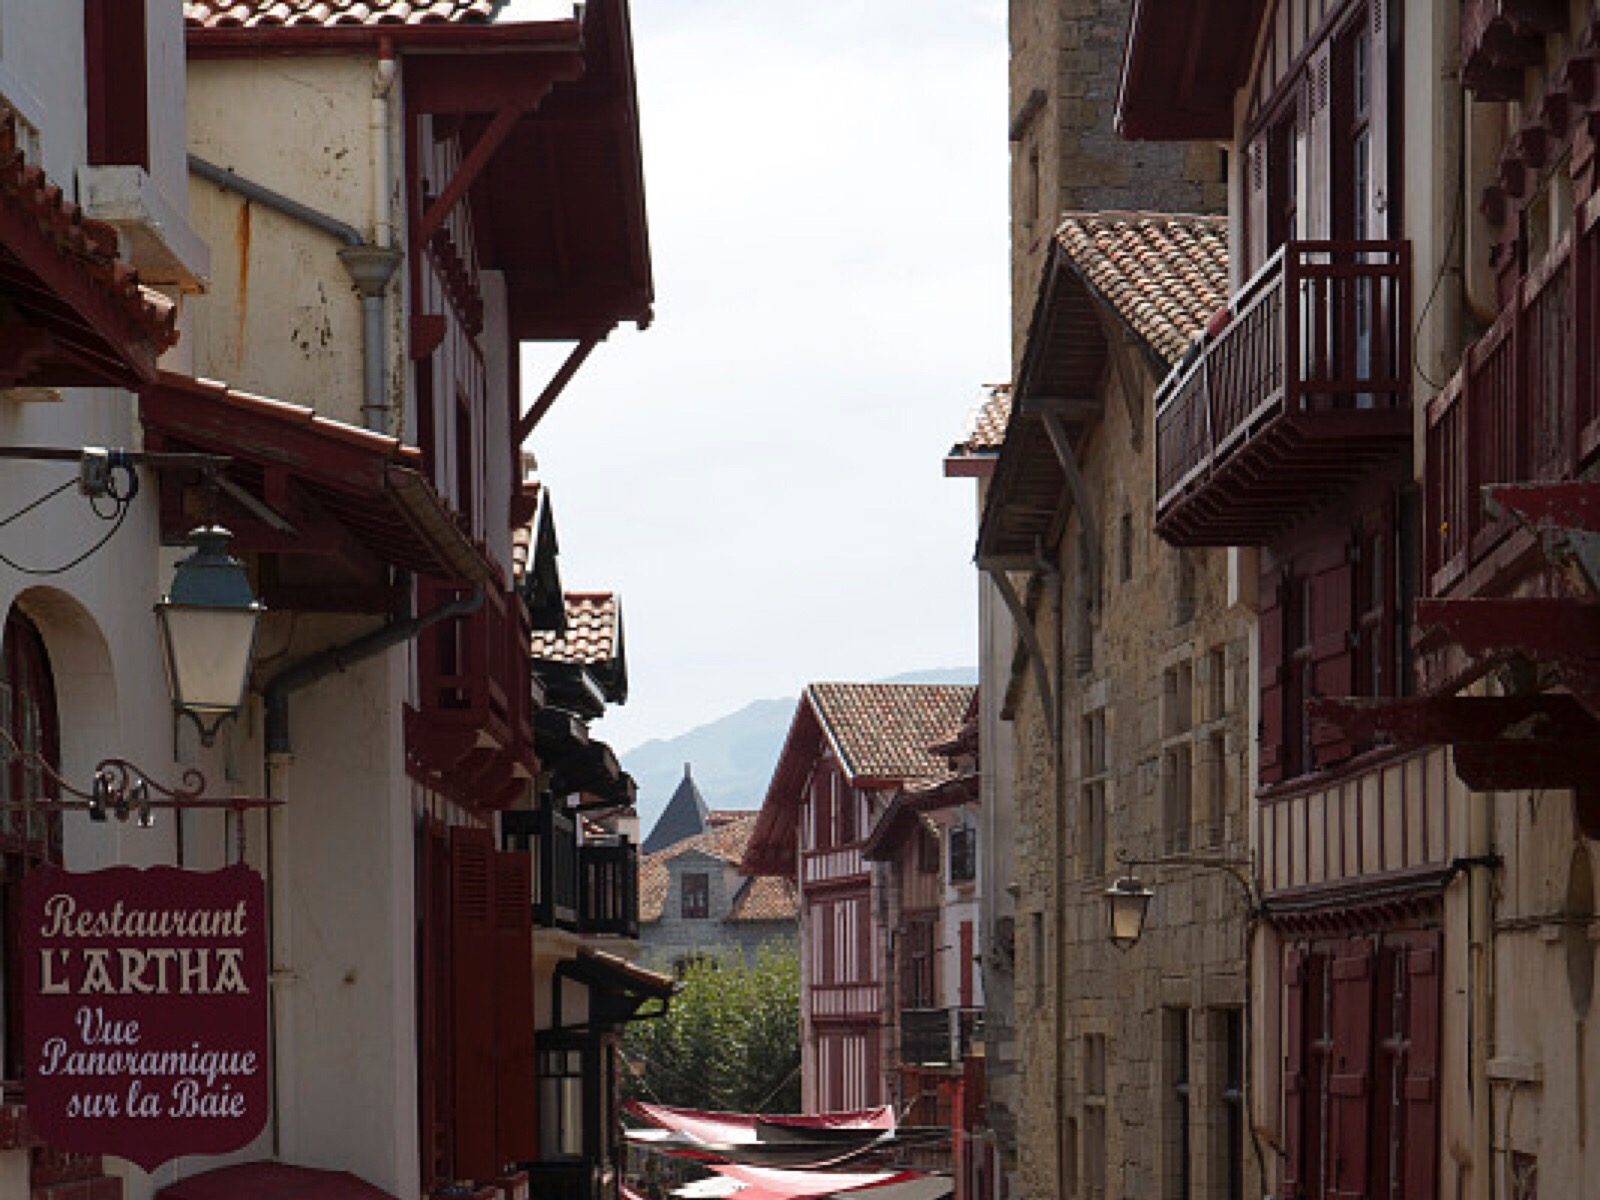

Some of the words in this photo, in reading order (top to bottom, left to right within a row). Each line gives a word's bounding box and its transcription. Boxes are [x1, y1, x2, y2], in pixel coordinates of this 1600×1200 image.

[41, 894, 248, 938] Restaurant
[40, 948, 250, 995] L'ARTHA
[76, 1005, 141, 1045] Vue
[38, 1037, 257, 1087] Panoramique
[66, 1090, 120, 1118] sur
[125, 1079, 162, 1118] la
[168, 1078, 247, 1118] Baie
